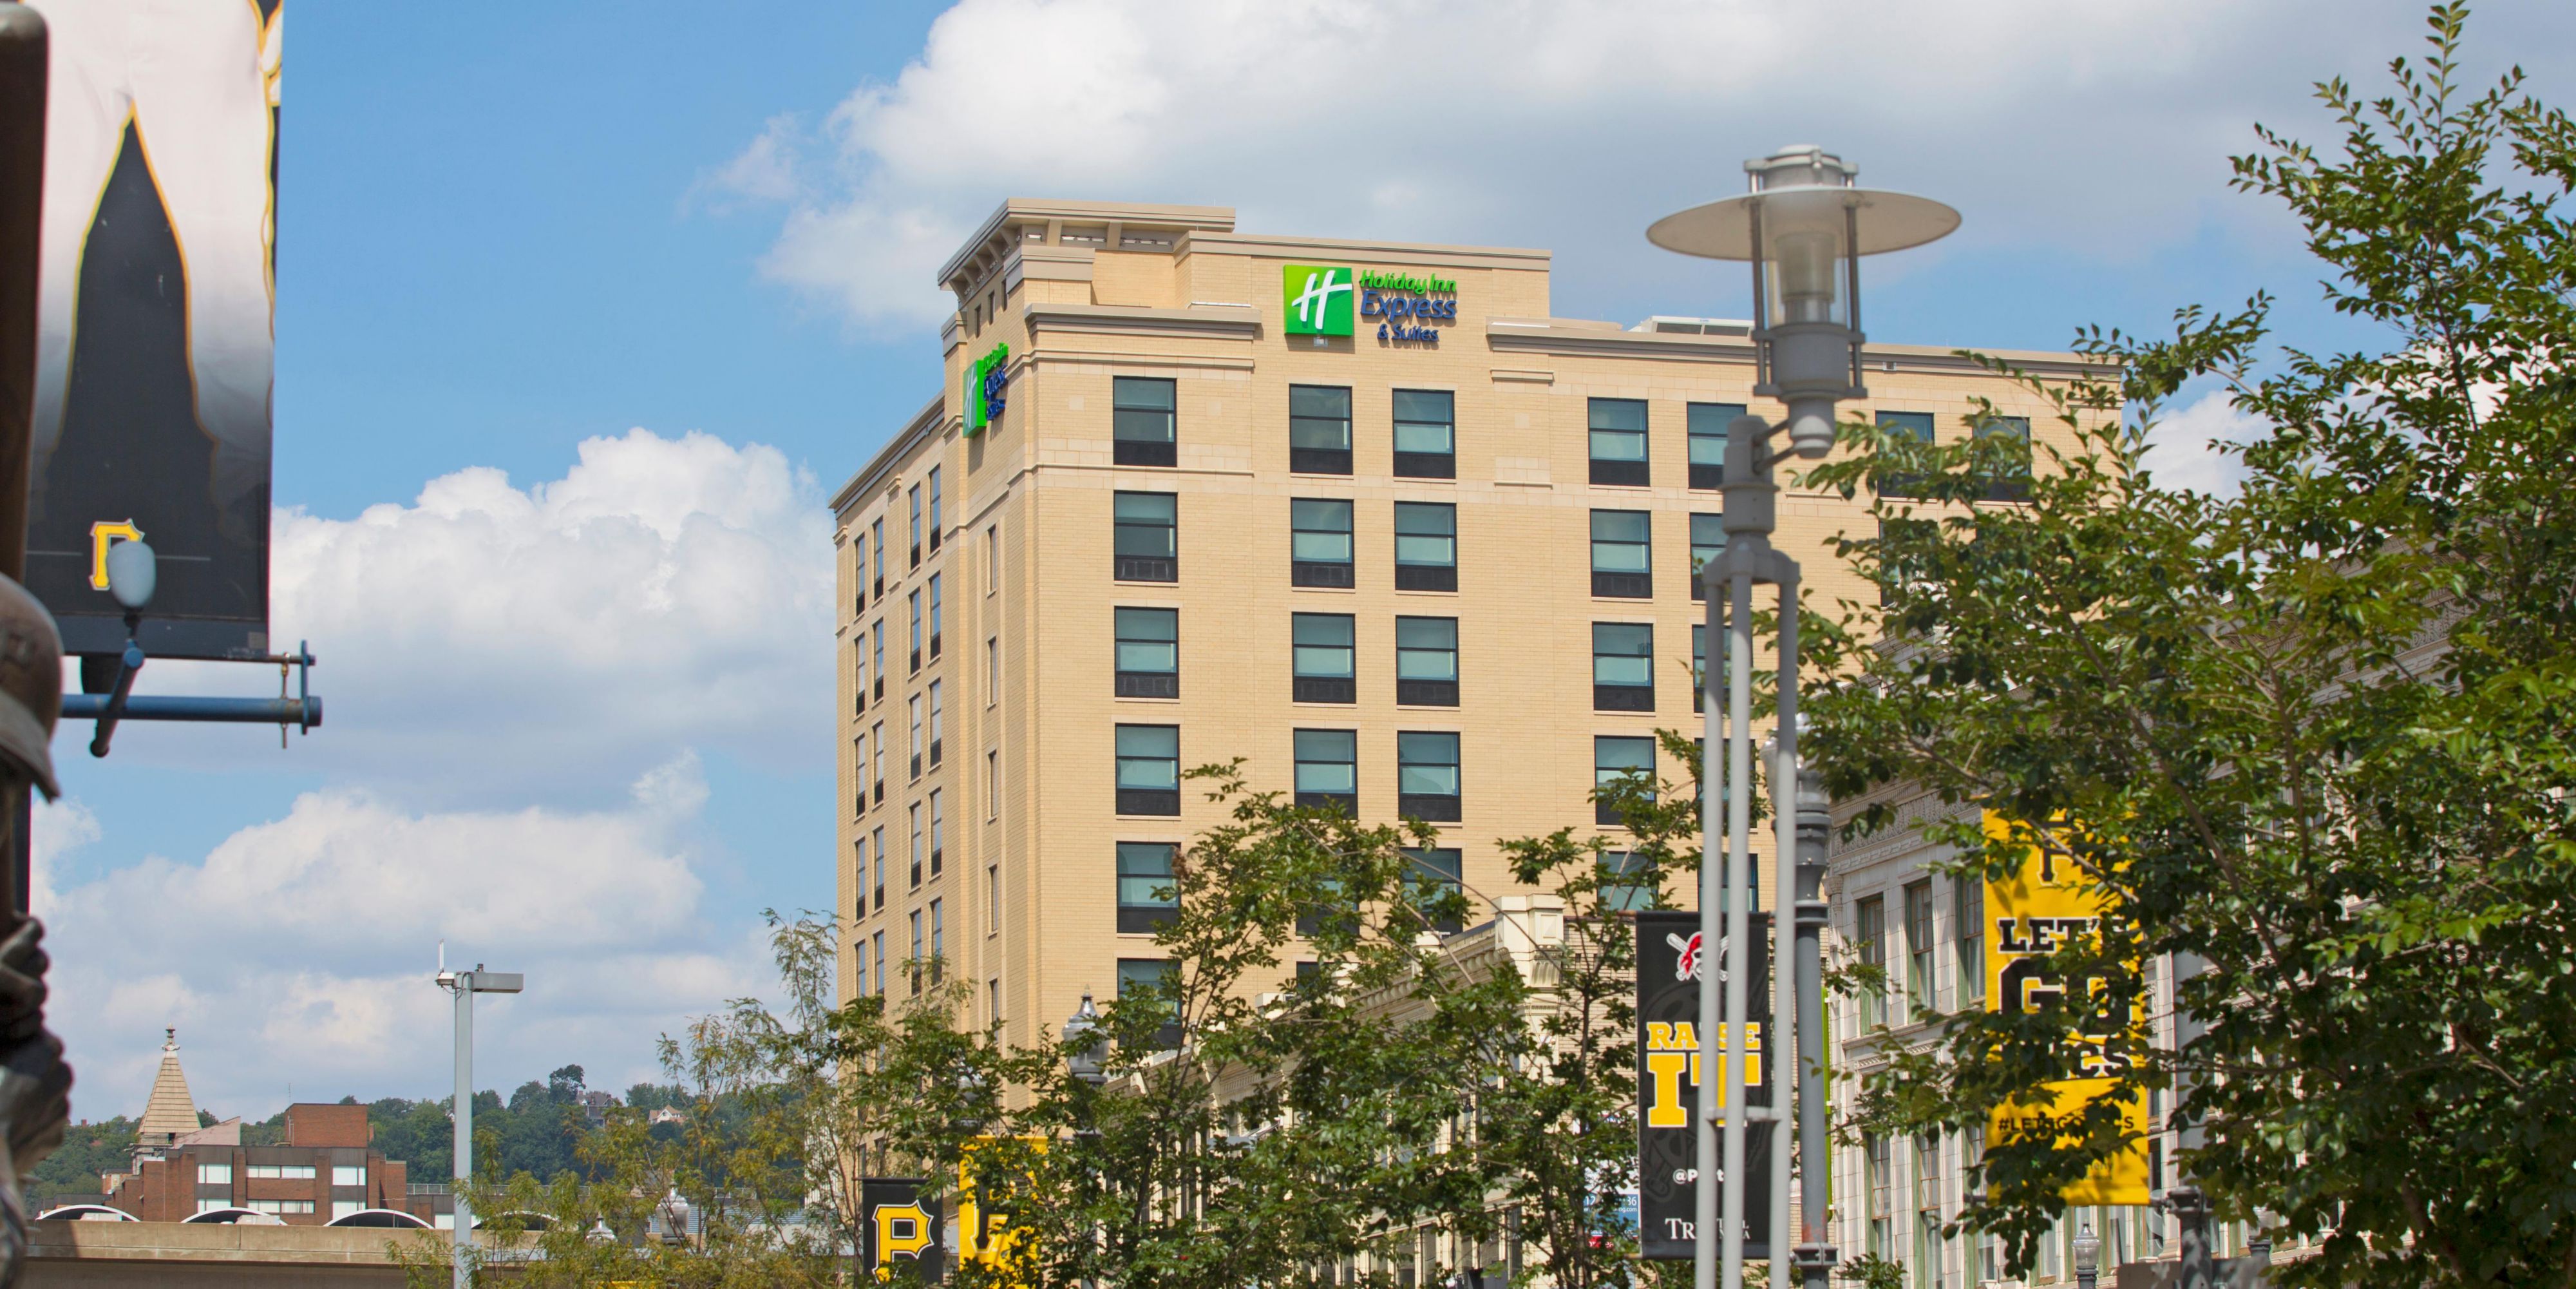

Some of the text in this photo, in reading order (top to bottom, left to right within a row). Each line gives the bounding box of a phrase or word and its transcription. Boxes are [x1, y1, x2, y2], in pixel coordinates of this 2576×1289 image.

[1359, 269, 1457, 294] Holiday Inn
[1361, 290, 1457, 322] Express
[1378, 323, 1439, 341] & Suites
[1647, 1022, 1761, 1051] RAE
[872, 1199, 934, 1285] P
